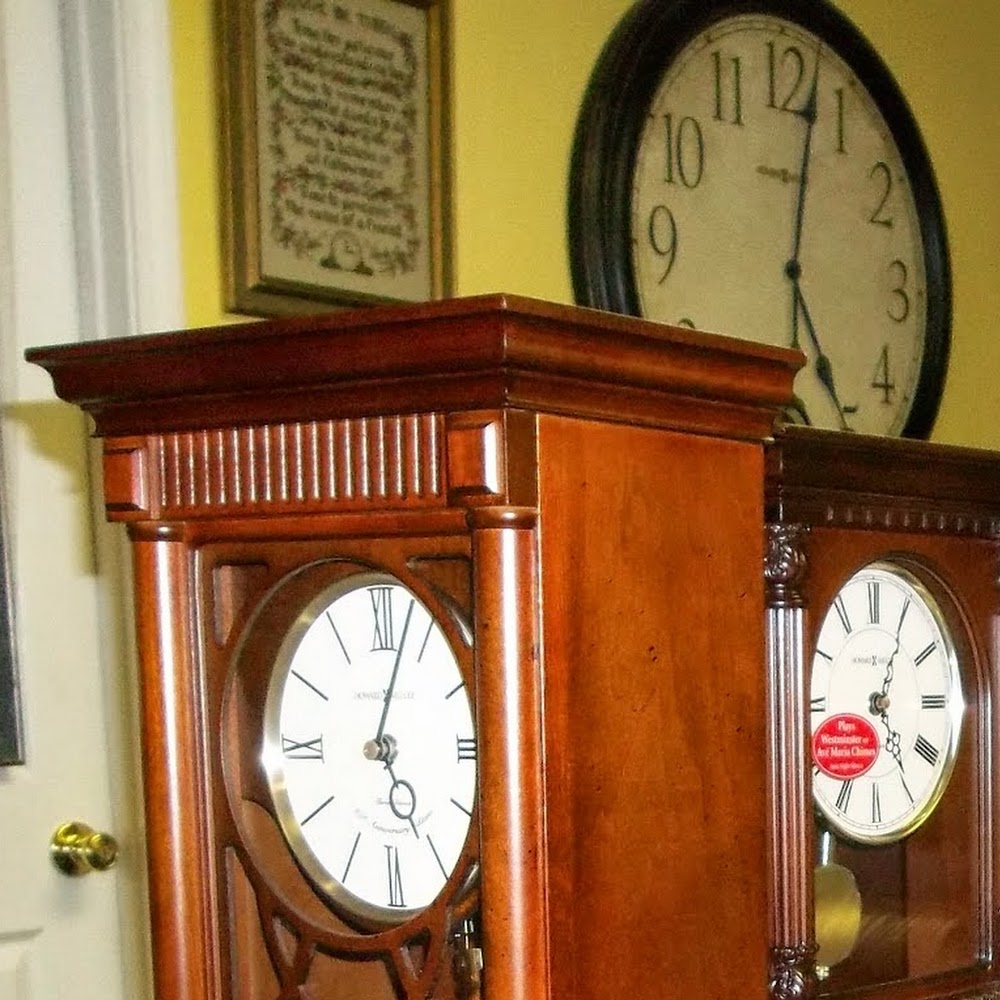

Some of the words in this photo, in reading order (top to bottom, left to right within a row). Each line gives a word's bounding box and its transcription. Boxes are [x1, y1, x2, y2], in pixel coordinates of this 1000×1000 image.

[711, 51, 744, 126] 11
[765, 40, 806, 114] 12
[664, 113, 705, 189] 10
[833, 88, 848, 155] 1
[868, 162, 893, 229] 2
[648, 205, 678, 286] 9
[886, 260, 910, 323] 3
[871, 343, 895, 403] 4
[367, 587, 398, 652] XII
